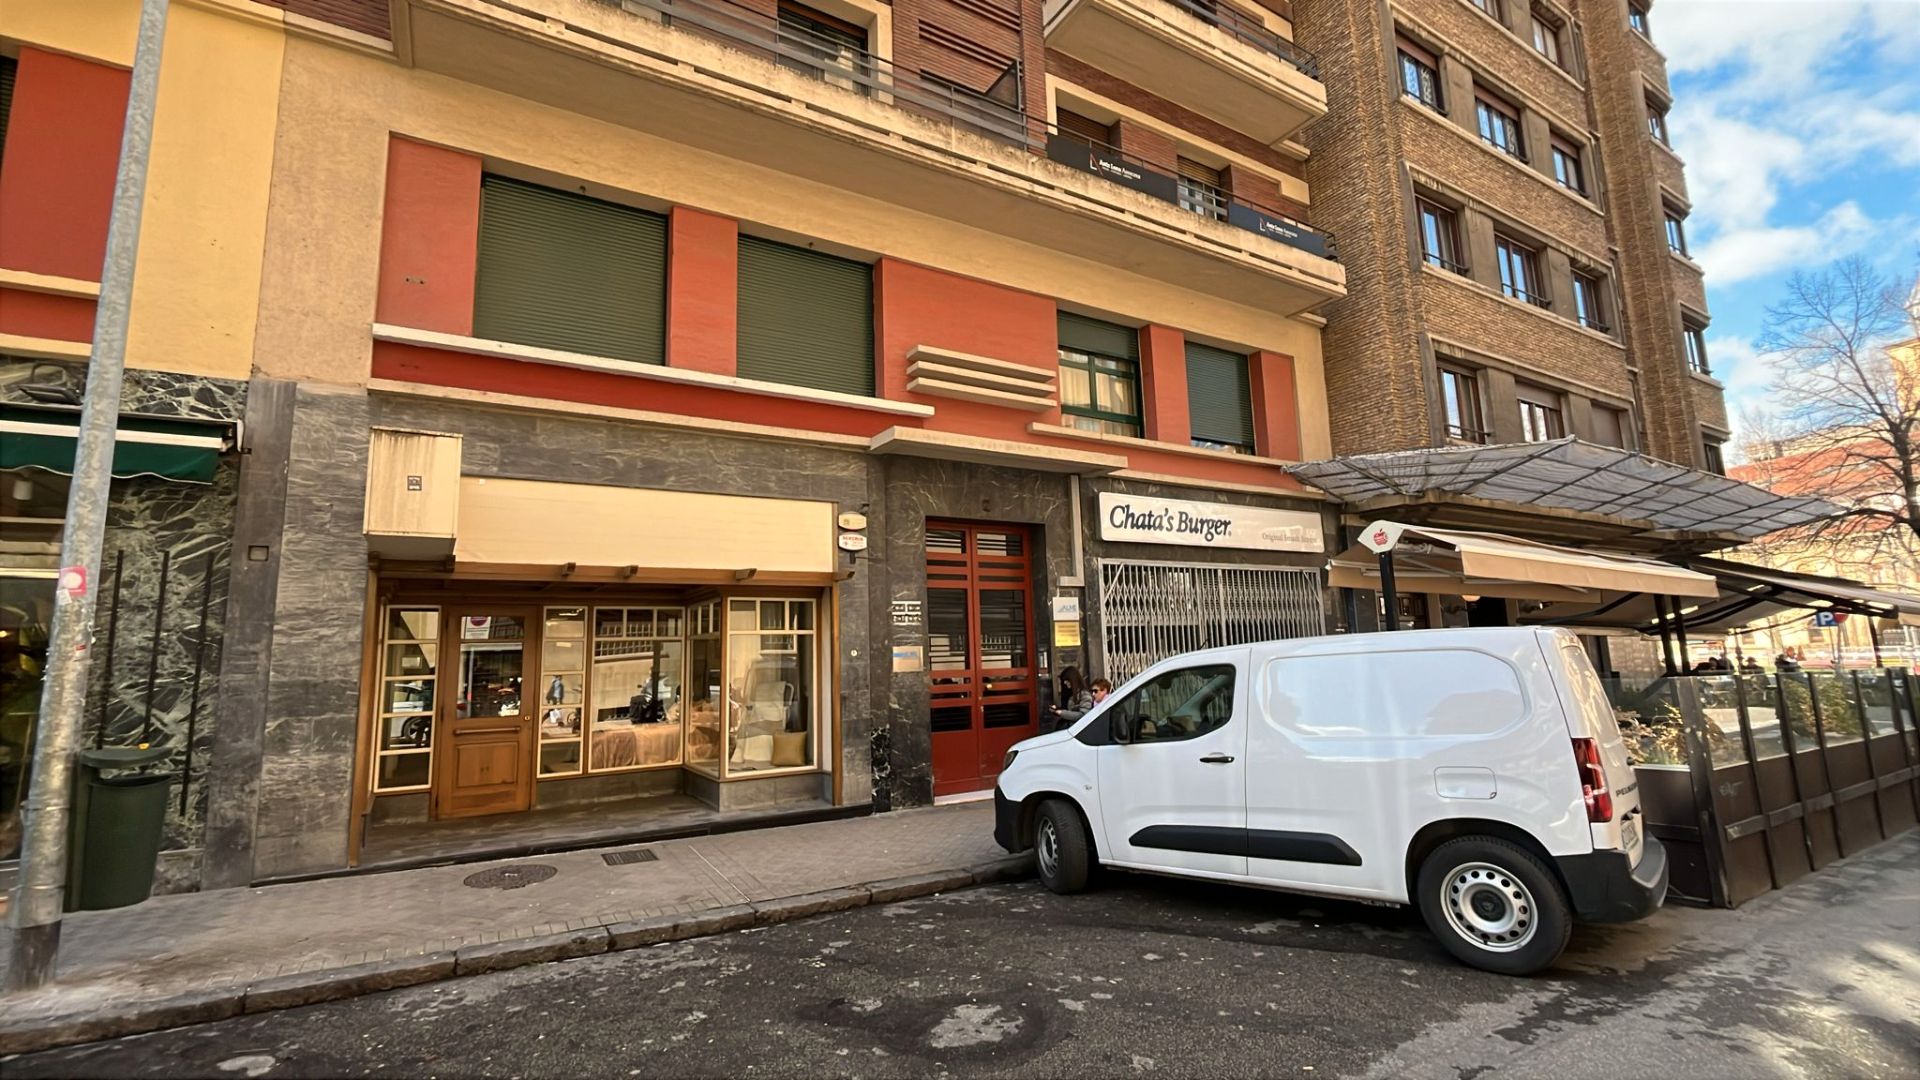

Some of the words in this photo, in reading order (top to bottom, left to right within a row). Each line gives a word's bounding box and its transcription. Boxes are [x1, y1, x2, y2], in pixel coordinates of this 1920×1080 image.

[1109, 504, 1174, 532] Chata's
[1176, 511, 1231, 542] Burger
[1820, 611, 1834, 626] P
